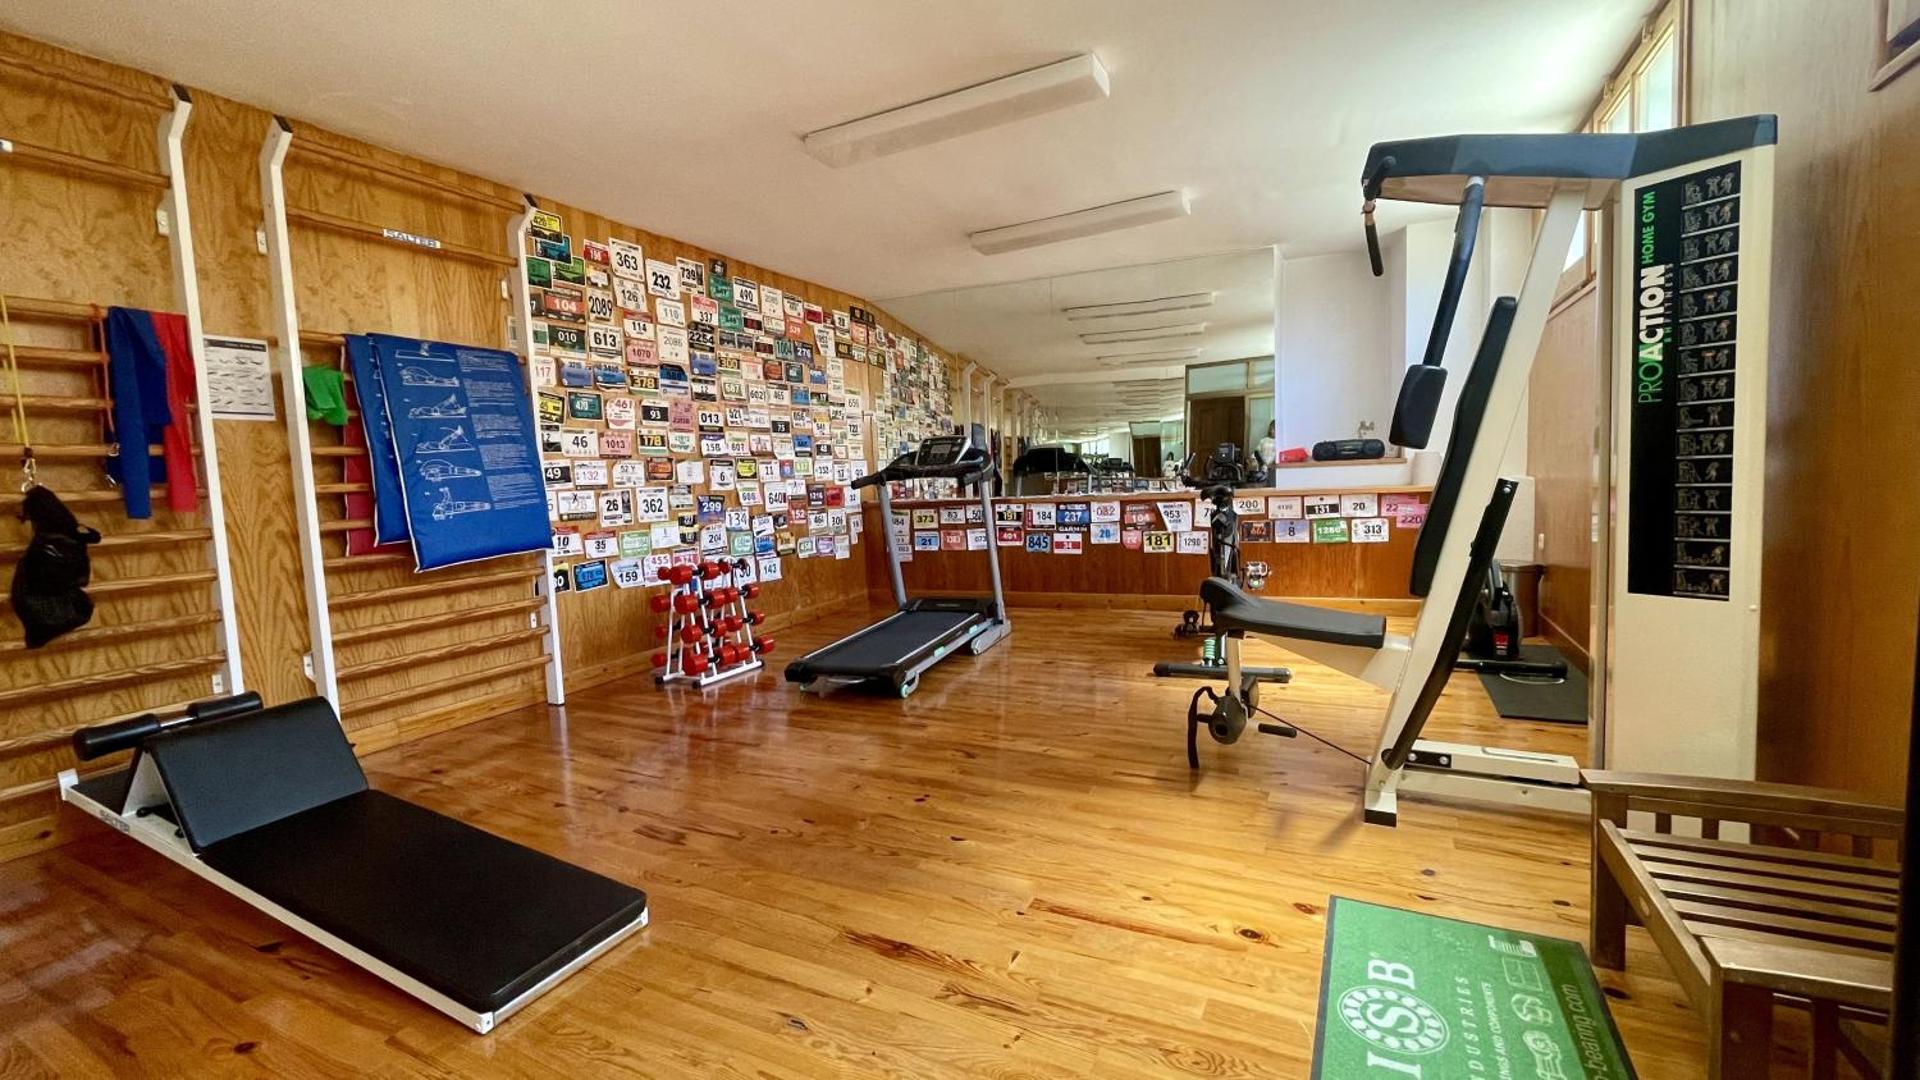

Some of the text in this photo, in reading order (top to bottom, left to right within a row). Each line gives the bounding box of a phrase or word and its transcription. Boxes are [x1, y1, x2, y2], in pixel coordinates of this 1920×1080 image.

[616, 252, 638, 271] 363
[680, 266, 696, 280] 739
[652, 272, 672, 290] 232
[1638, 191, 1666, 404] PROACTION HOME GYM
[554, 300, 577, 312] 104
[588, 296, 613, 317] 2089
[593, 332, 617, 348] 613
[700, 412, 720, 424] 013
[572, 436, 588, 448] 46
[606, 440, 626, 449] 1013
[643, 436, 662, 446] 178
[546, 468, 562, 479] 49
[720, 471, 726, 482] 6
[606, 500, 619, 512] 26
[642, 498, 664, 514] 362
[702, 502, 722, 512] 299
[1352, 502, 1366, 511] 20
[1288, 526, 1296, 537] 8
[1364, 525, 1382, 535] 313
[594, 540, 606, 550] 35
[922, 538, 932, 546] 21
[1028, 536, 1048, 548] 845
[1145, 535, 1171, 546] 181
[618, 572, 638, 583] 159
